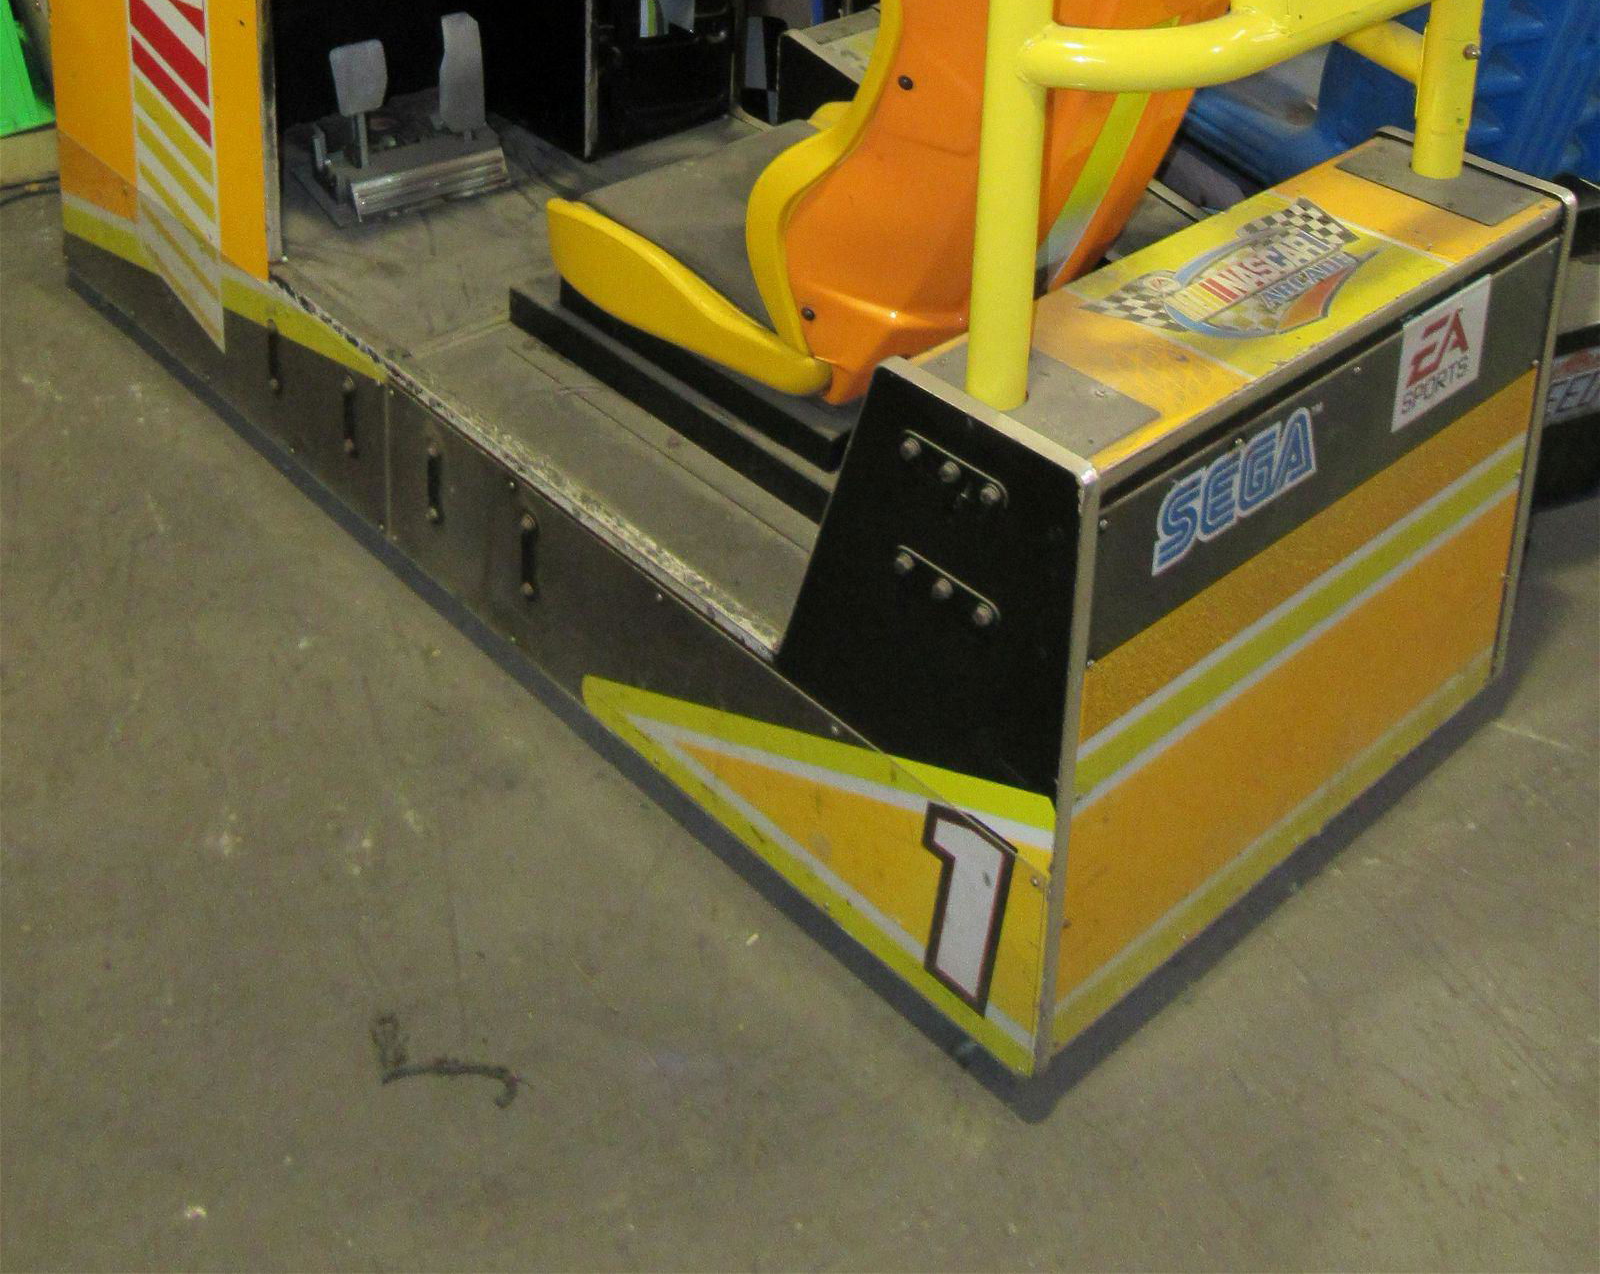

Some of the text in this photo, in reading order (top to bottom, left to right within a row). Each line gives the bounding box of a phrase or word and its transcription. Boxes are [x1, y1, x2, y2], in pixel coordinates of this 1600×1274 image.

[1212, 229, 1332, 296] NASCAR
[1401, 355, 1469, 415] SPORTS
[1406, 309, 1469, 387] EA
[1151, 407, 1317, 576] SEGA
[922, 801, 1018, 1018] 1
